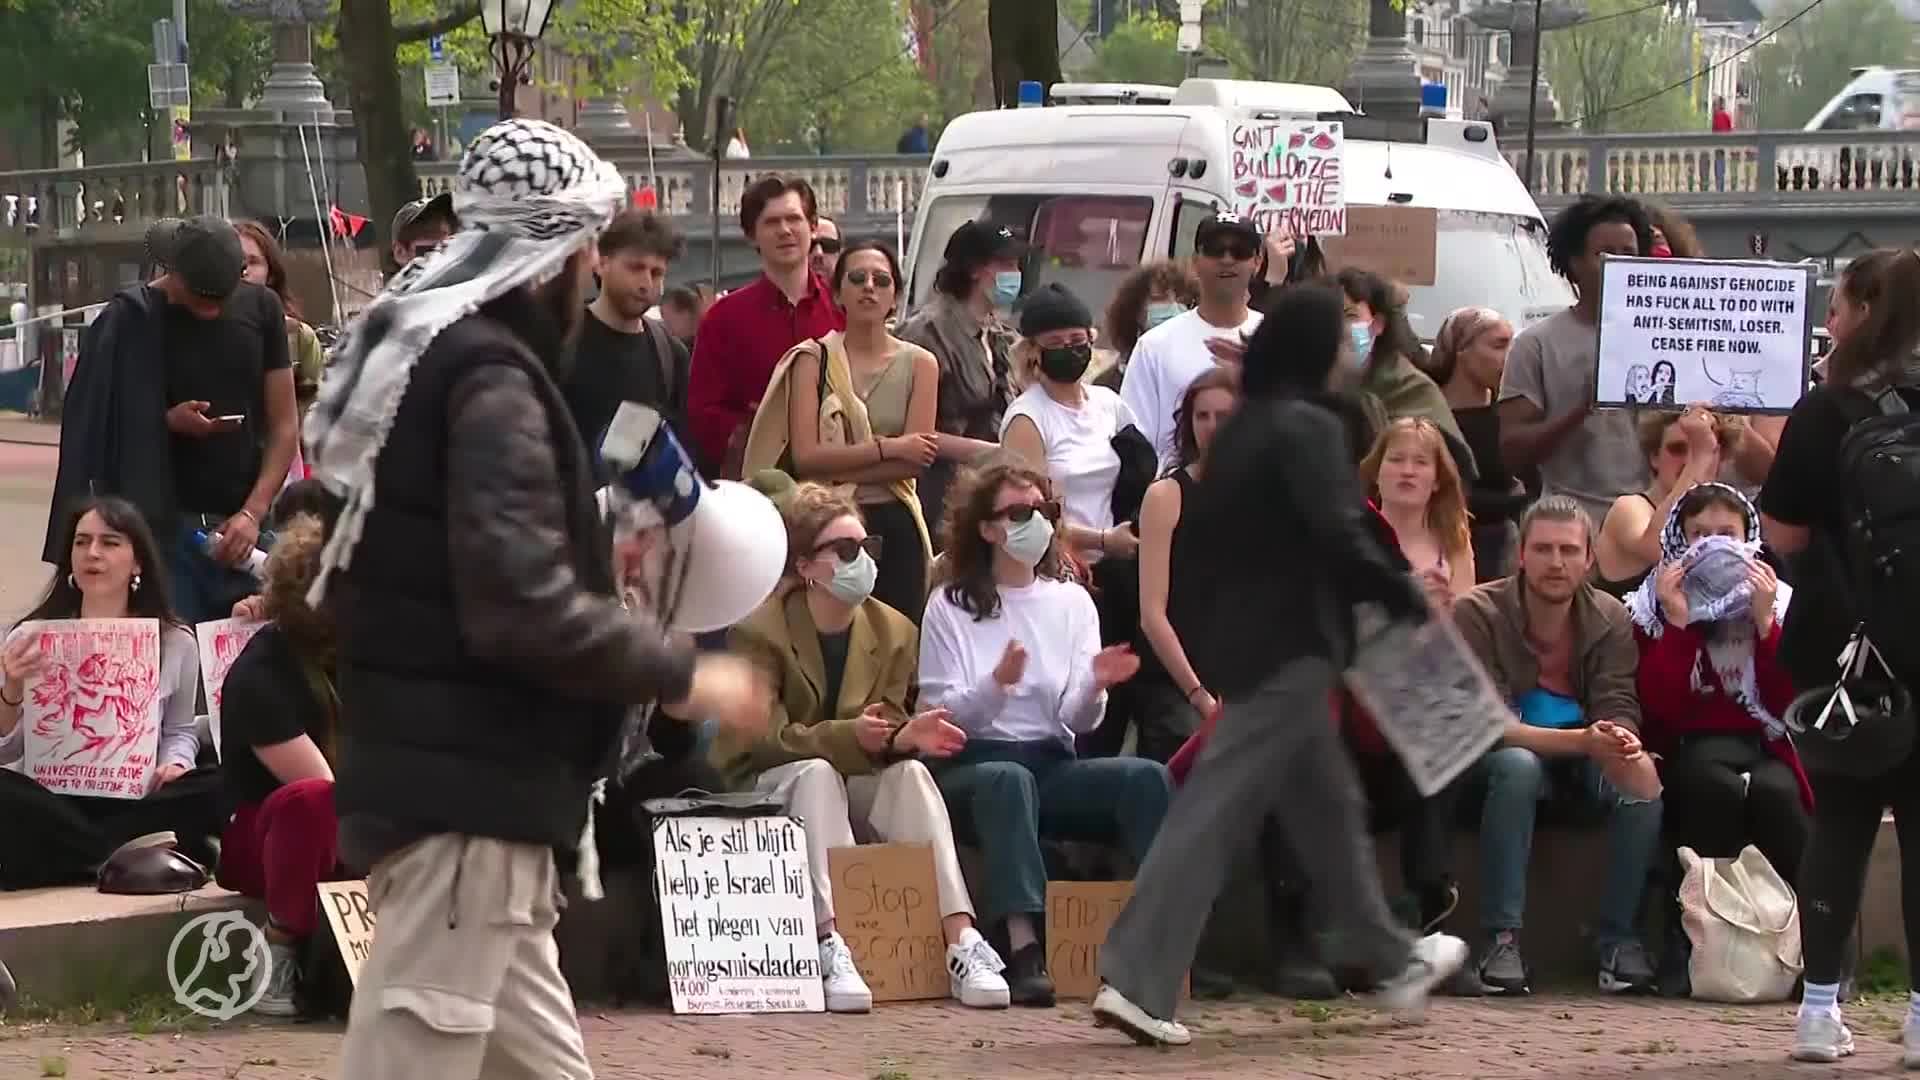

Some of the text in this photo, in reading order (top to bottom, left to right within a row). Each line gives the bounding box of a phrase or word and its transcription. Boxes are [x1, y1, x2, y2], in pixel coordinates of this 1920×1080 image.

[1294, 181, 1340, 205] THE
[1627, 274, 1796, 292] BEING AGAINST GENOCIDE
[1626, 295, 1794, 313] HAS FUCK ALL TO DO WITH
[1633, 316, 1784, 334] ANTI-SEMITISM, LOSER.
[1652, 337, 1761, 354] CEASE FIRE NOW.
[665, 820, 797, 858] Als je stil blijft
[661, 859, 805, 900] help je Israel bij
[843, 863, 922, 928] Stop
[329, 891, 376, 933] PR
[671, 902, 804, 942] het plegen van
[668, 943, 820, 982] oorlogsmisdaden
